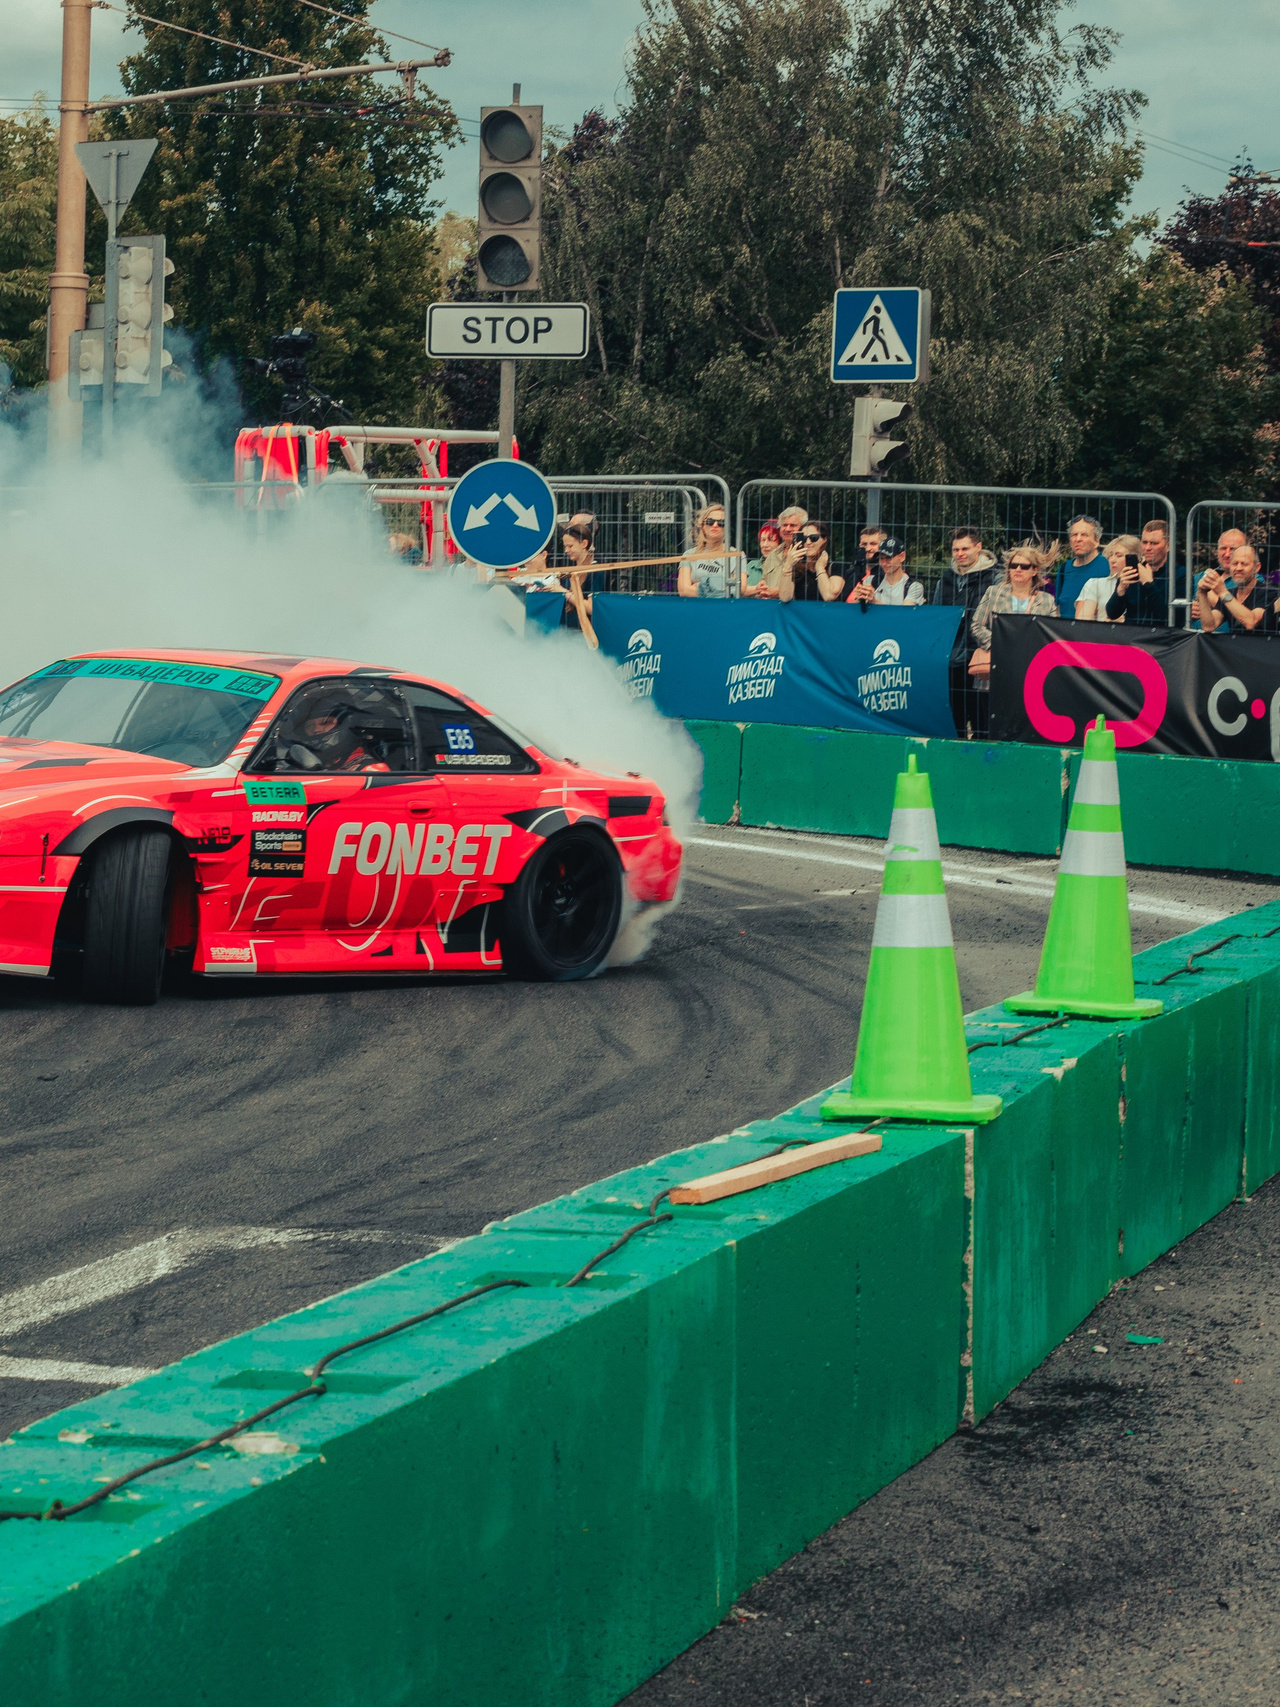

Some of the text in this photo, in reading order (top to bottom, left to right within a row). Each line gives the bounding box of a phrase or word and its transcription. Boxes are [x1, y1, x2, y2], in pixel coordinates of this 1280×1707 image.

[462, 316, 553, 344] STOP
[90, 663, 220, 685] ШУБАДЁРОВ
[726, 656, 785, 687] ЛИМОНАД
[857, 666, 912, 698] ЛИМОНАД
[729, 678, 777, 705] КАЗБЕГИ
[445, 728, 474, 750] E85
[254, 831, 298, 841] Blockchain
[254, 841, 282, 852] Sports
[327, 821, 513, 876] FONBET
[274, 862, 304, 871] SEVEN
